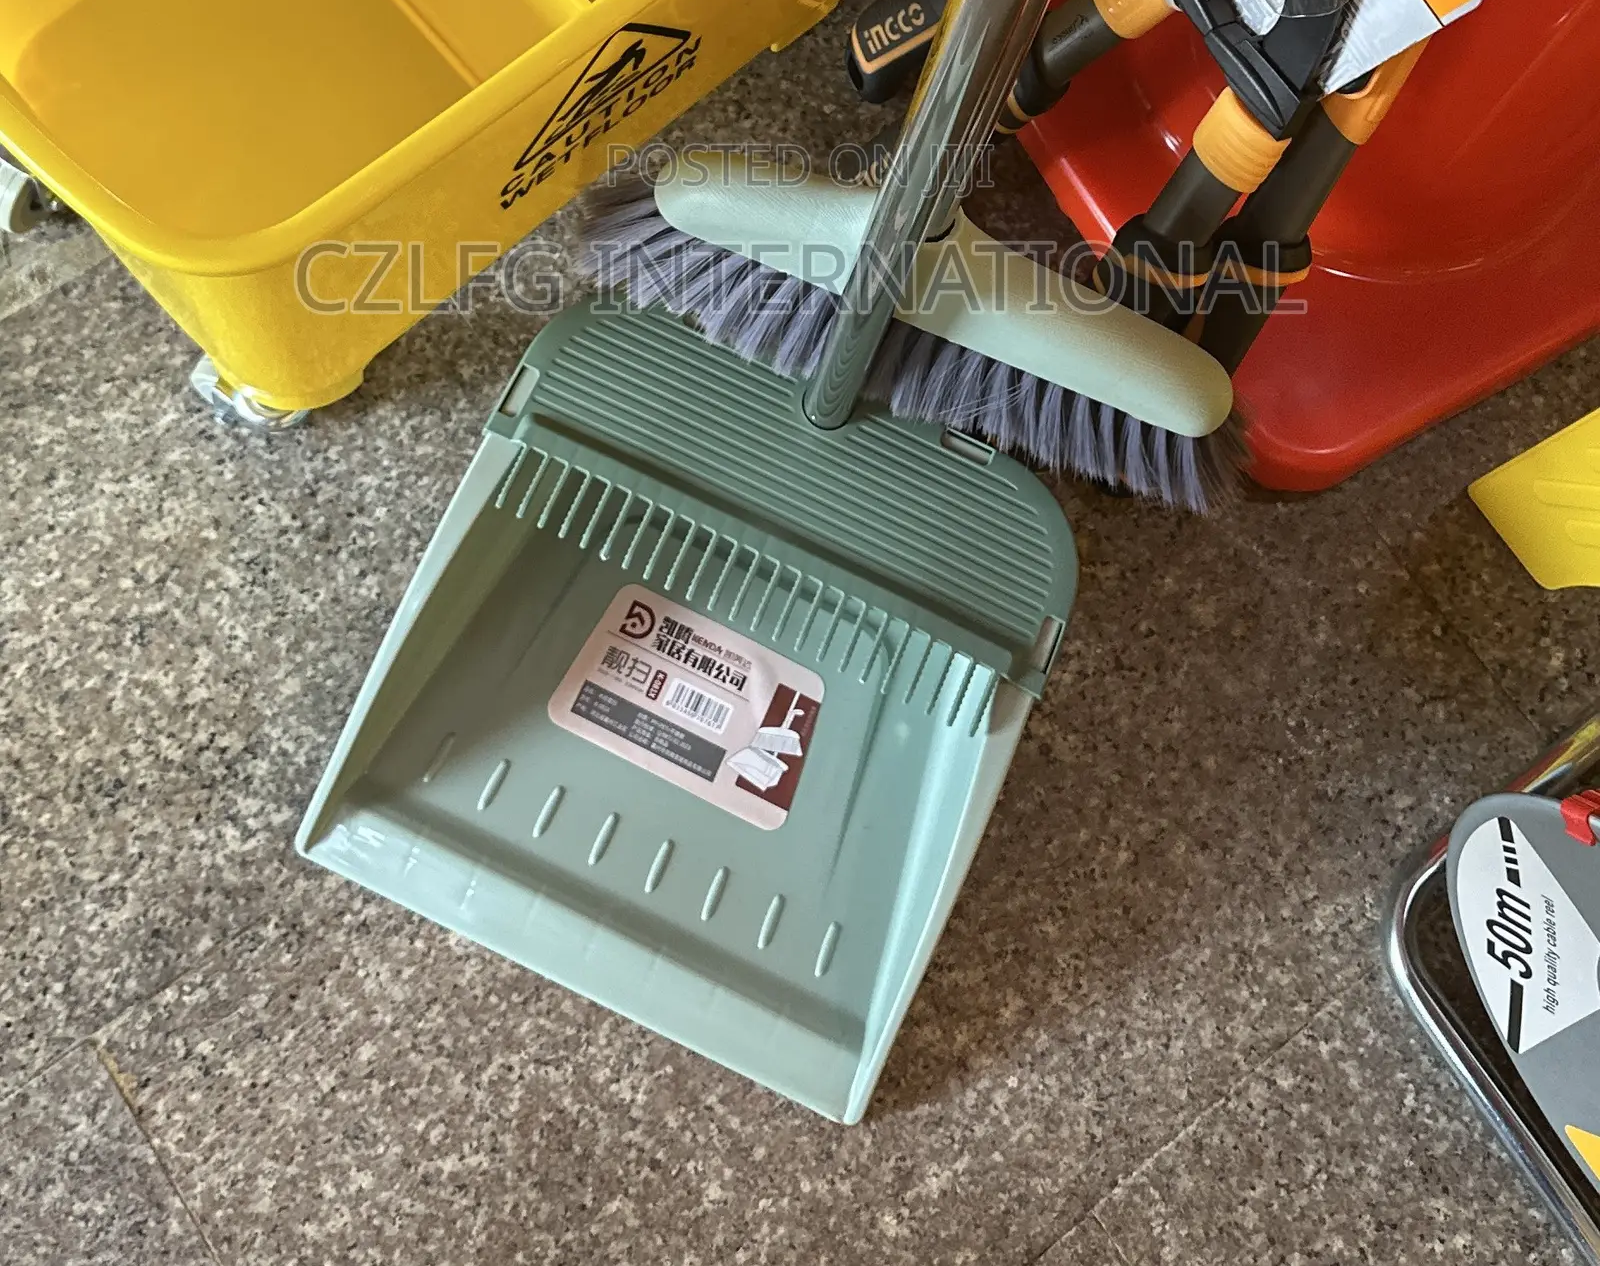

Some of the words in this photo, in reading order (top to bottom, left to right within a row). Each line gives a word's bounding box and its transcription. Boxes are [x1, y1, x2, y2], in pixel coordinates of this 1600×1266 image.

[500, 34, 702, 197] CAUTION
[651, 634, 749, 692] 家居有限公司
[1541, 894, 1555, 918] reel
[1486, 887, 1533, 980] 50m
[1543, 918, 1557, 947] cable
[1544, 947, 1560, 986] quality
[1542, 987, 1559, 1015] high
